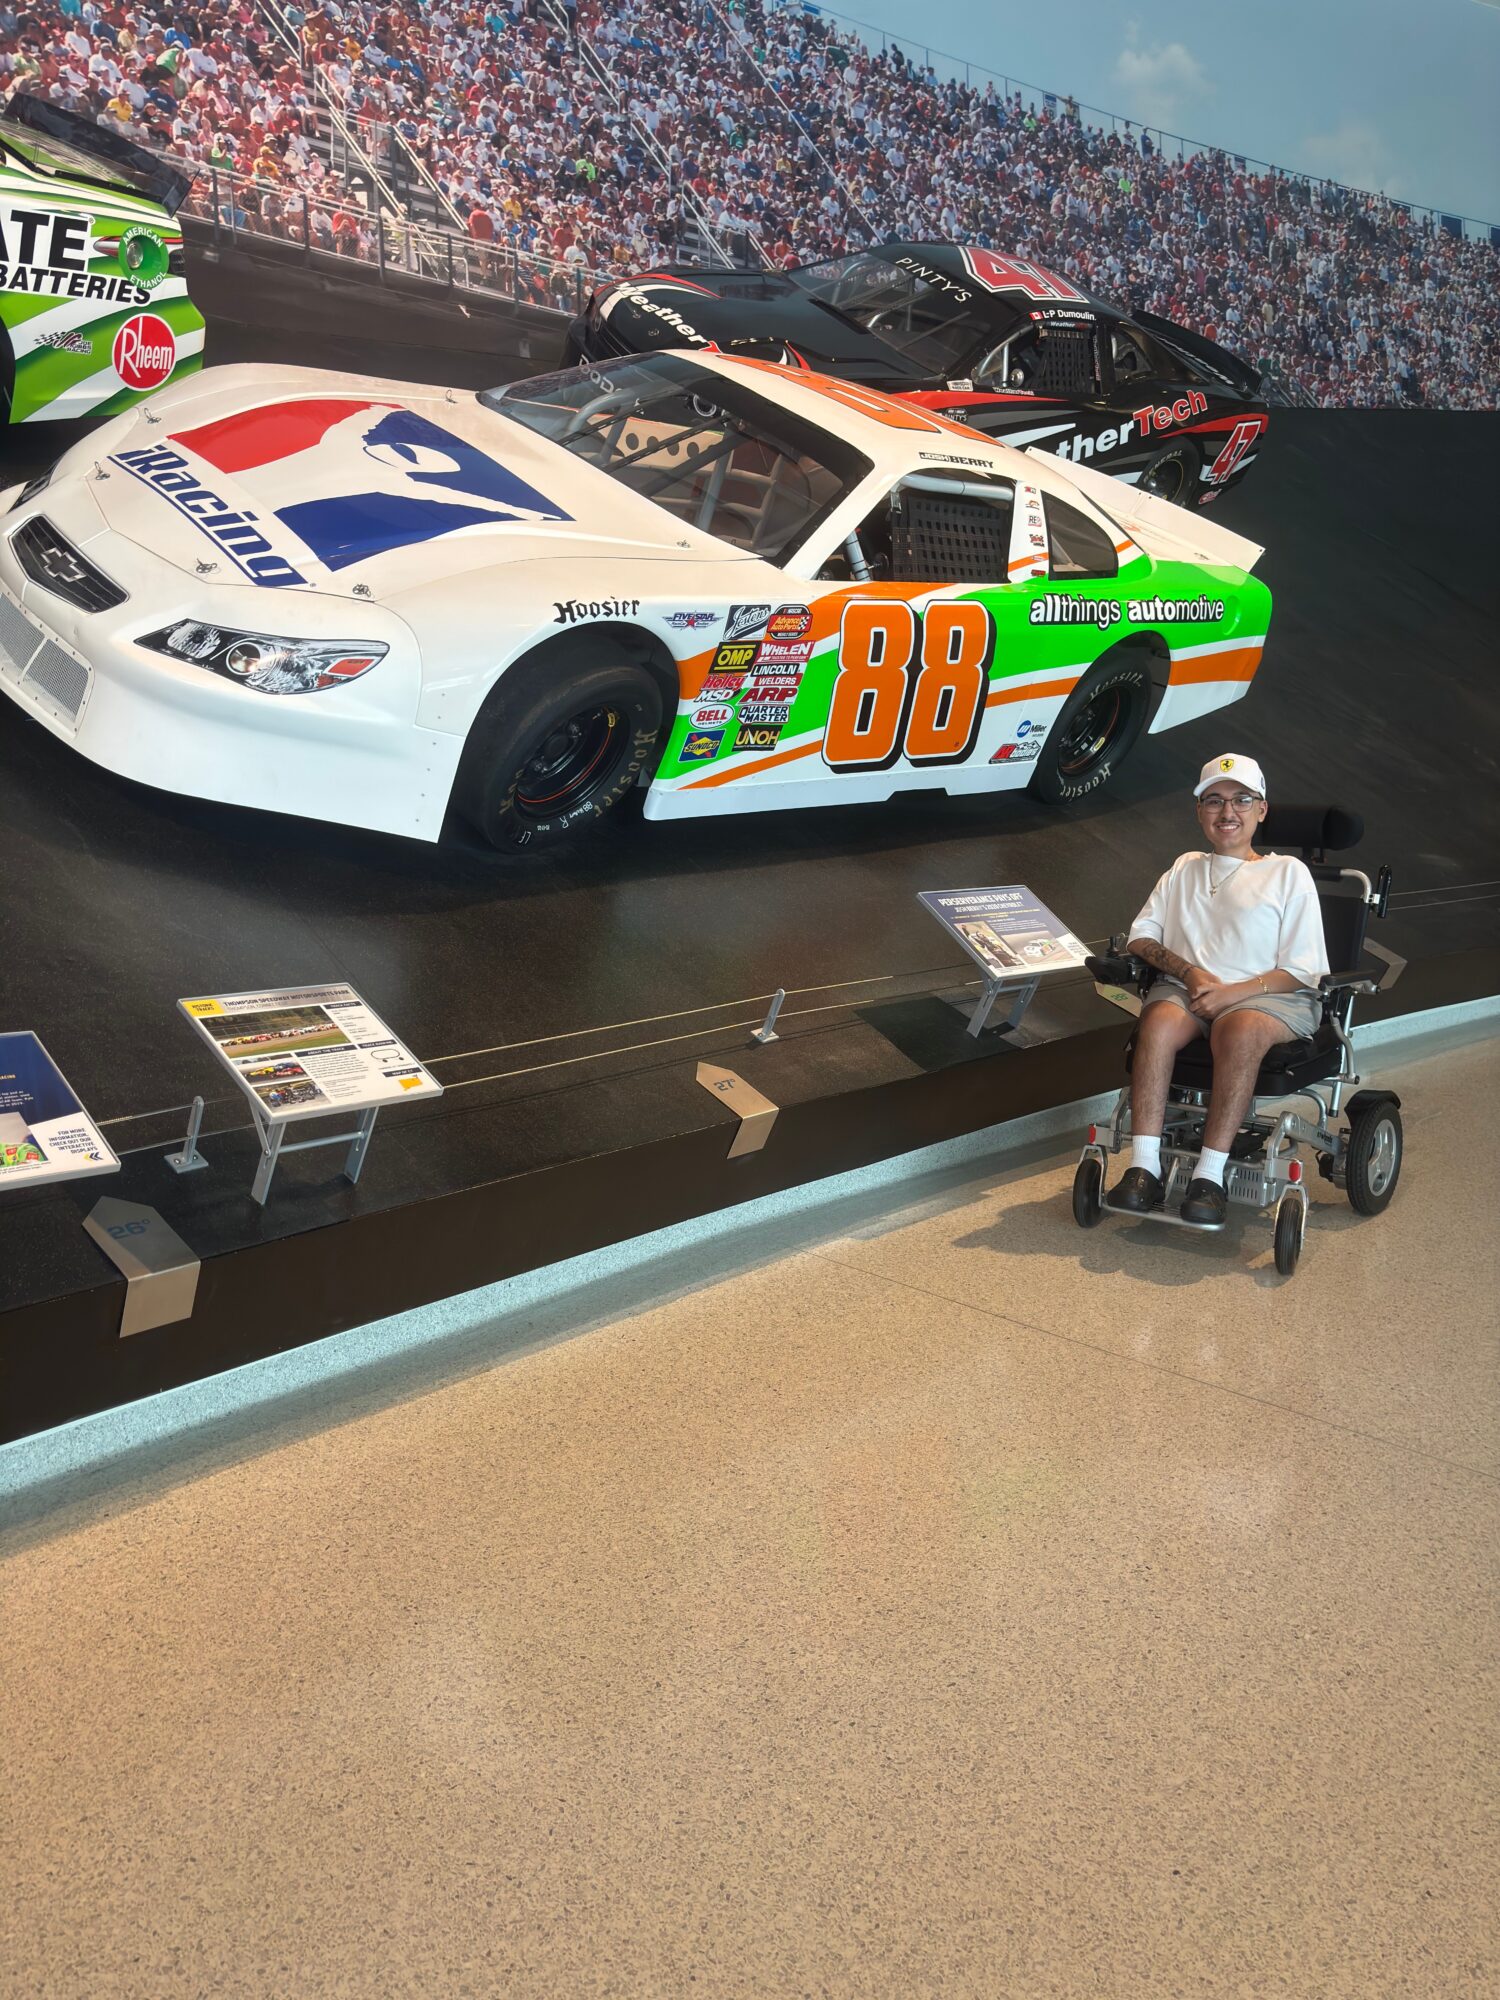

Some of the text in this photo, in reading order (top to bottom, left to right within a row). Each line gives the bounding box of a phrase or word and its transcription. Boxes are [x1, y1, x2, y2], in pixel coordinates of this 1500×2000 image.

[0, 209, 89, 271] TE
[123, 226, 164, 248] AMERICAN
[130, 271, 167, 288] ETHANOL
[896, 256, 973, 303] PINTY'S
[119, 316, 172, 378] Rheem
[1209, 420, 1262, 485] 47
[949, 456, 994, 468] BERRY
[106, 444, 309, 588] iRacing
[552, 595, 640, 624] Hoosier
[673, 613, 715, 621] FIVE STAR
[1128, 596, 1225, 622] automotive
[776, 616, 800, 624] Advance
[718, 649, 754, 665] OMP
[760, 642, 811, 656] WHELEN
[753, 664, 797, 675] LINCOLN
[701, 673, 748, 690] Holley
[758, 677, 797, 685] WELDERS
[821, 599, 995, 771] 88
[694, 688, 736, 702] MSD
[739, 688, 798, 702] ARP
[696, 710, 728, 722] BELL
[740, 706, 788, 718] QUARTER
[744, 713, 787, 723] MASTER
[736, 728, 780, 745] UNOH
[684, 740, 720, 752] SUNOCO
